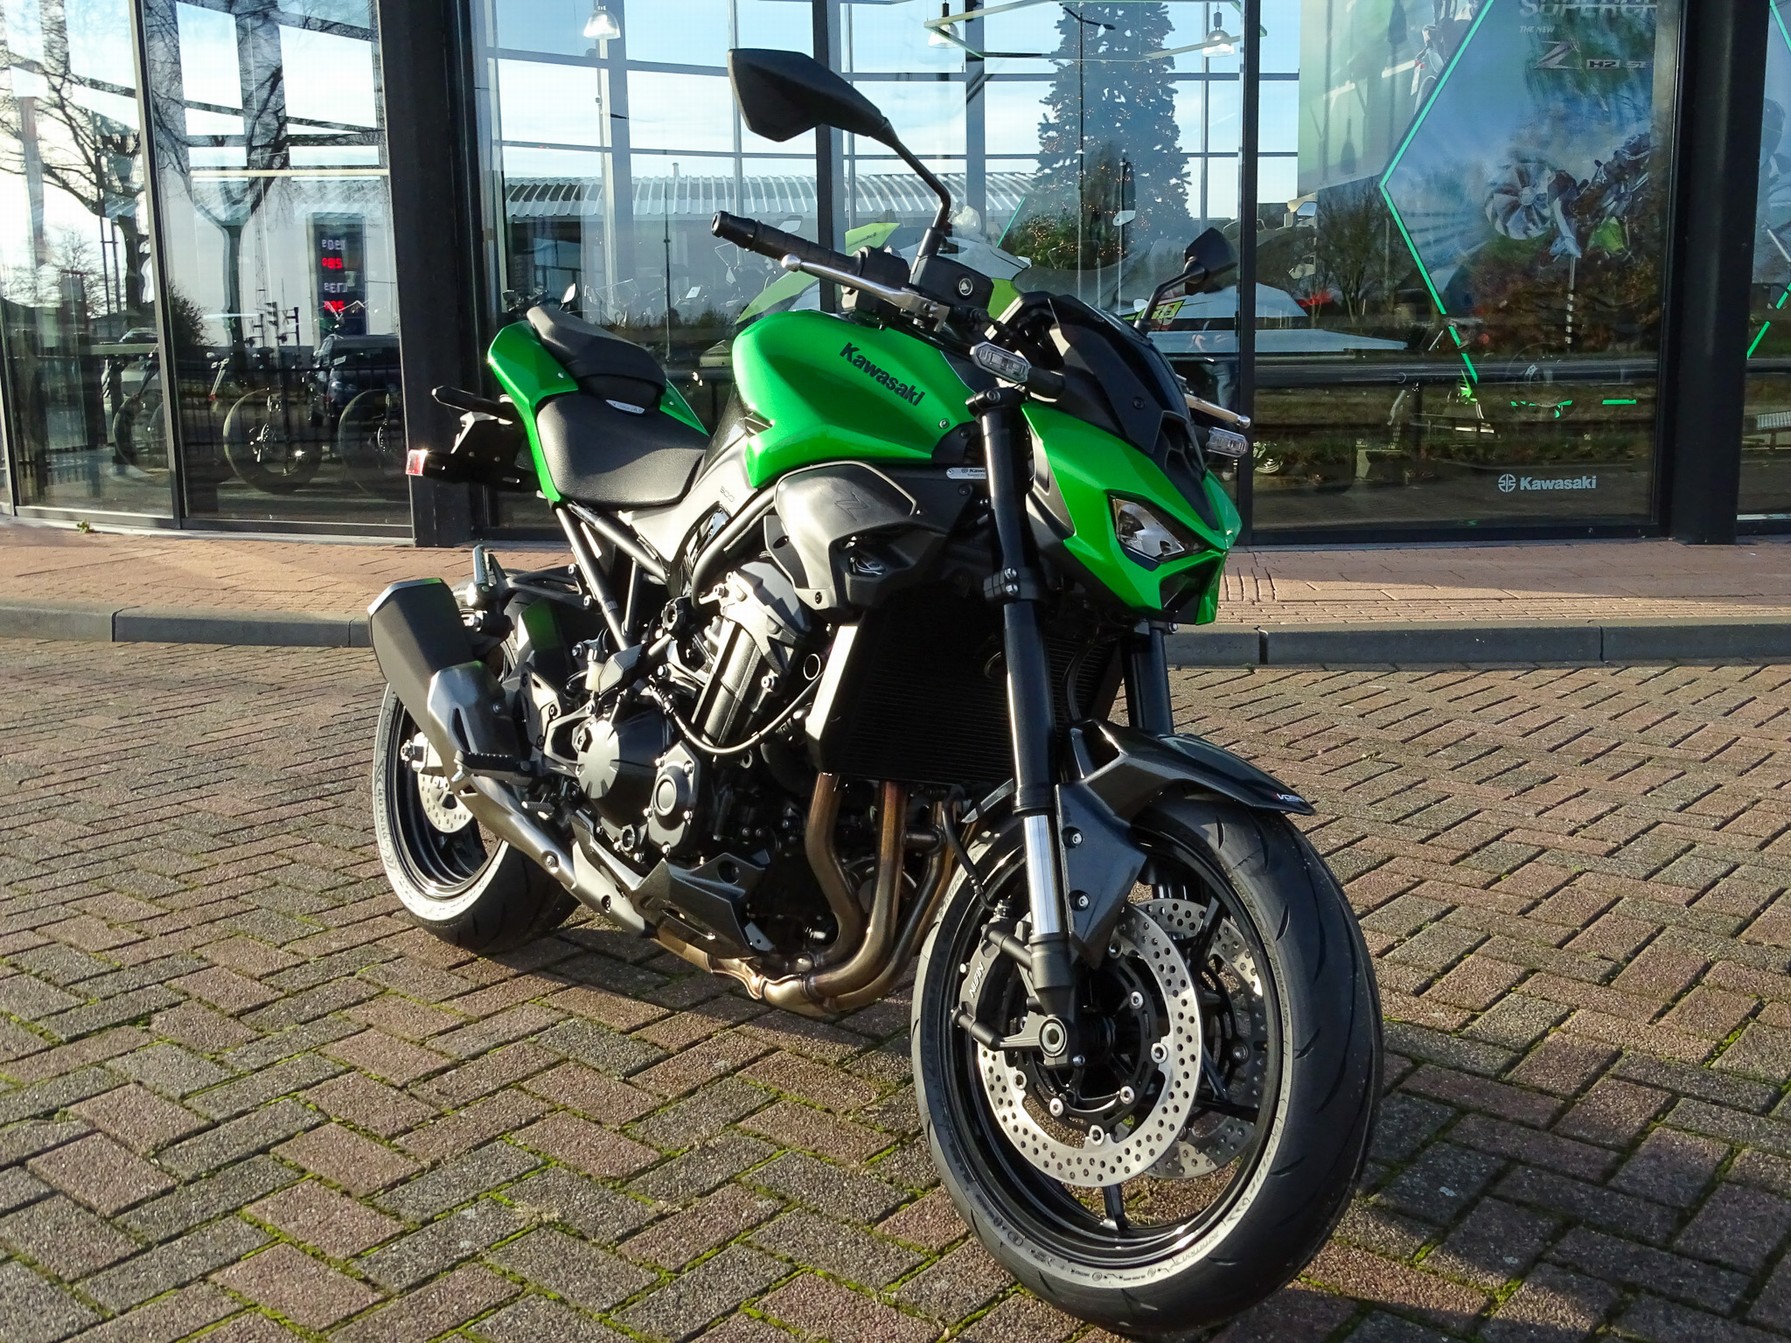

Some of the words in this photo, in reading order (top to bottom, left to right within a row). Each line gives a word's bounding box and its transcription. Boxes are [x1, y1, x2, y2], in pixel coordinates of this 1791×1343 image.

[1520, 25, 1534, 33] THE
[1536, 25, 1555, 33] NEW
[1588, 60, 1618, 69] H2
[840, 342, 925, 406] Kawasaki
[1520, 476, 1596, 490] Kawasaki
